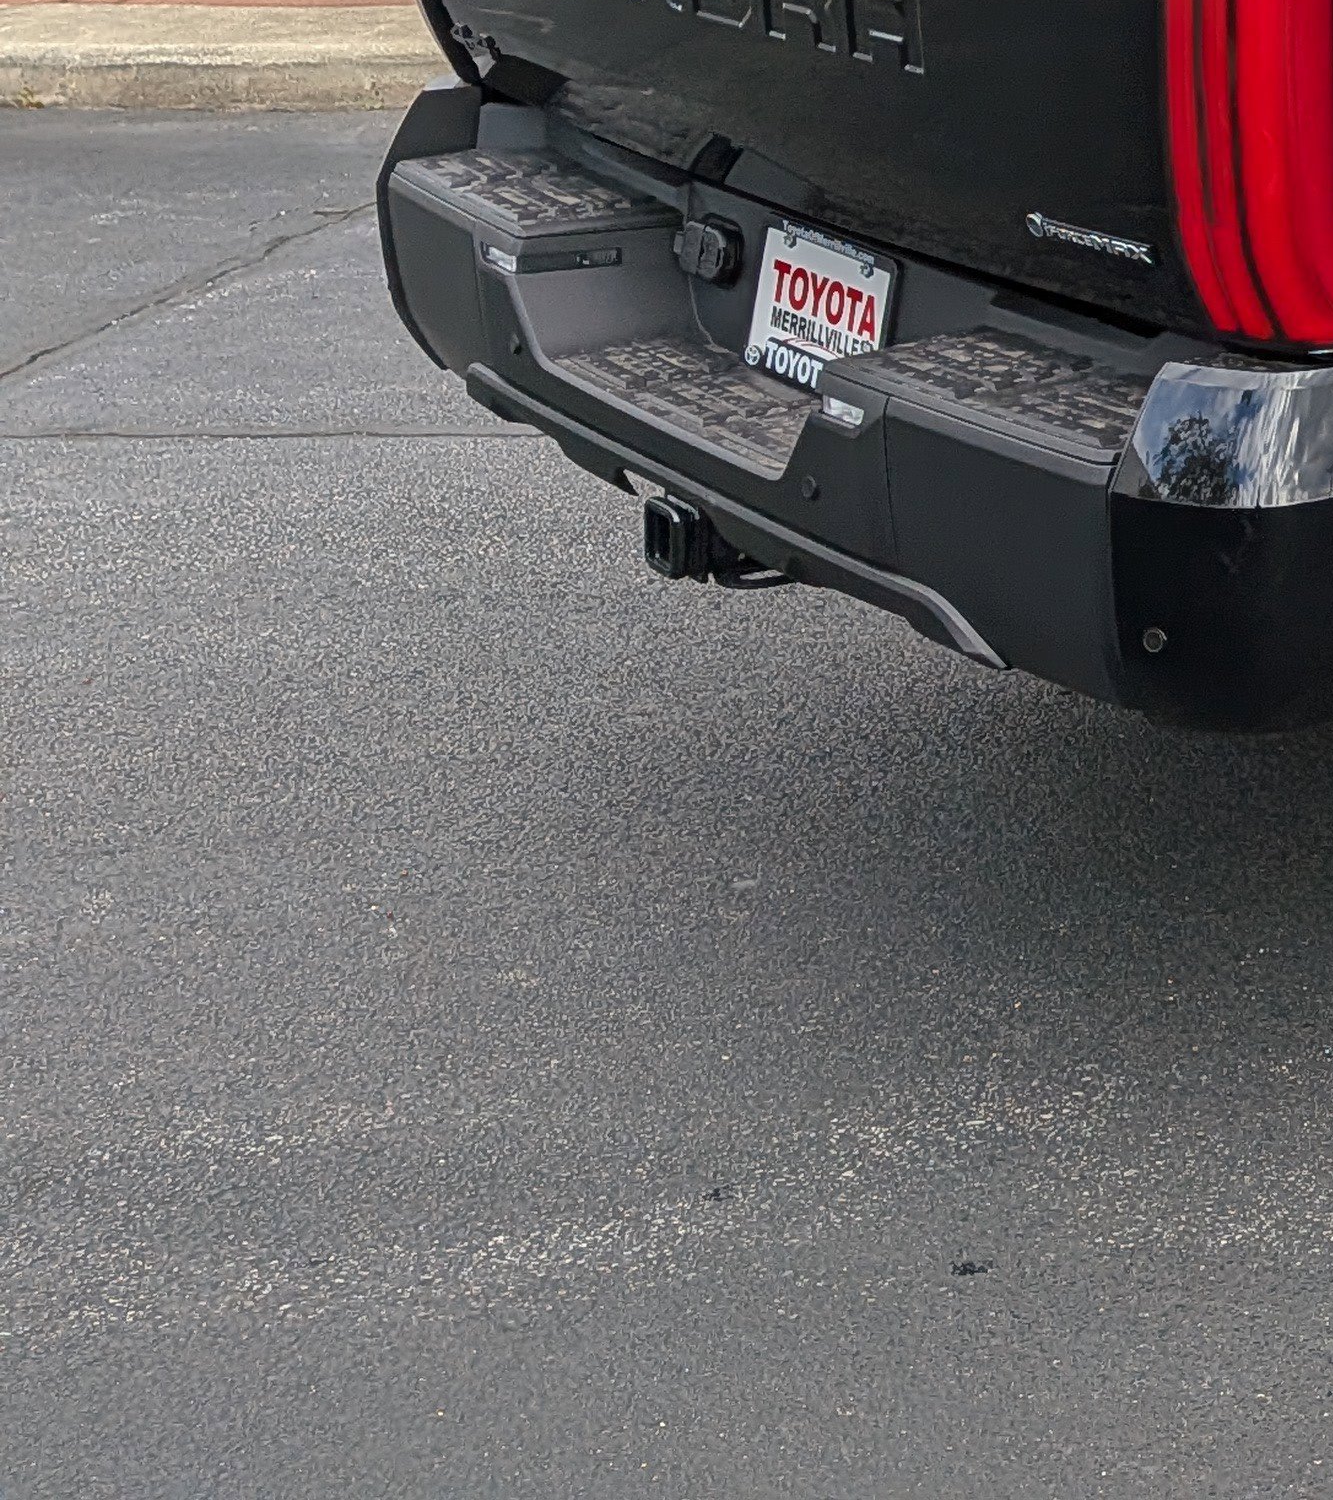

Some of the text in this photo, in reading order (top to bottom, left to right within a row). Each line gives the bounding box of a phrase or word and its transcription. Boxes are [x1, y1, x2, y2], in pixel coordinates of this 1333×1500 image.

[773, 258, 877, 342] TOYOTA
[770, 305, 862, 357] MERRILLVILLE
[764, 339, 824, 389] TOYOT
